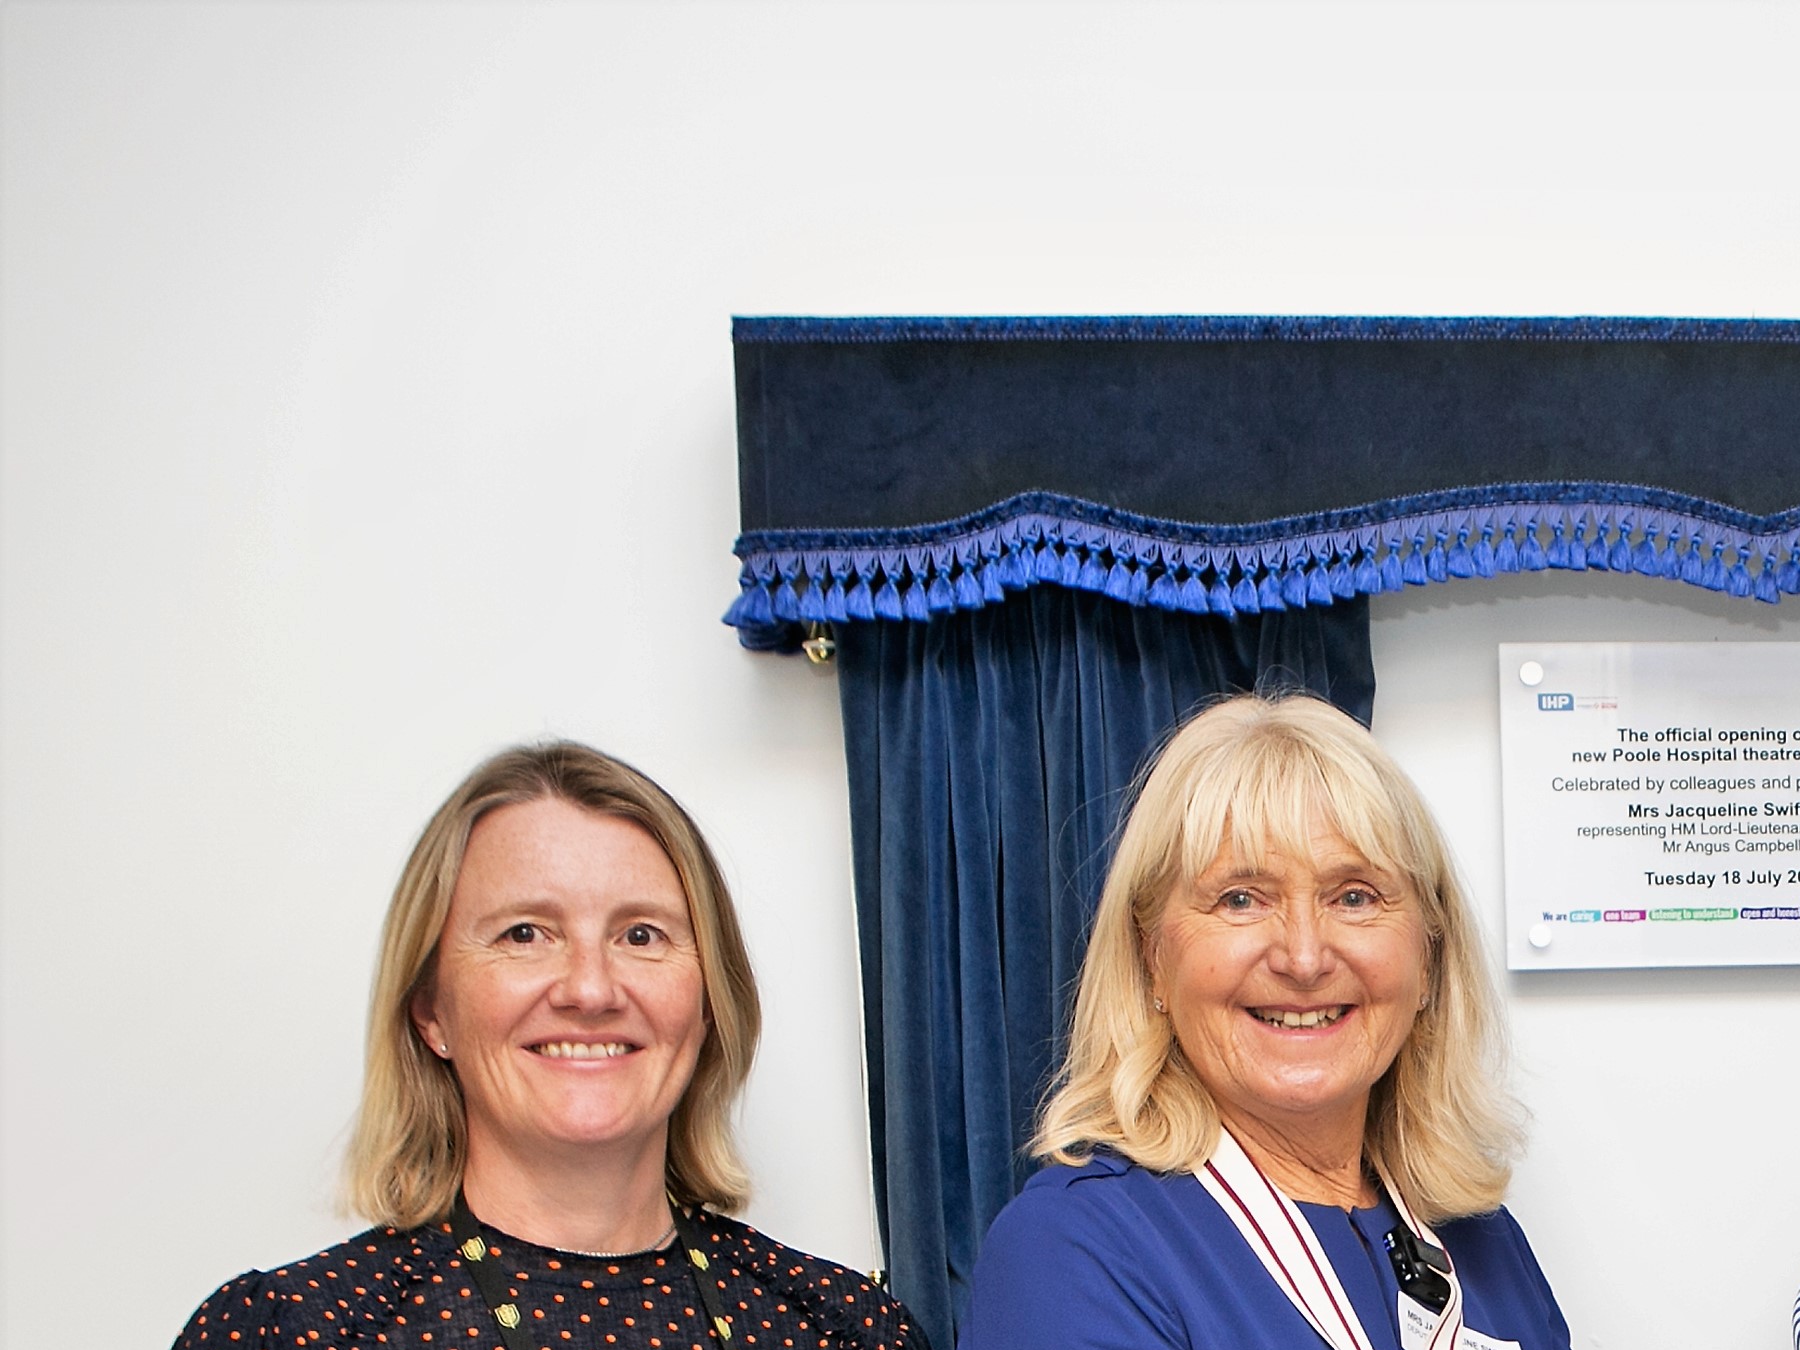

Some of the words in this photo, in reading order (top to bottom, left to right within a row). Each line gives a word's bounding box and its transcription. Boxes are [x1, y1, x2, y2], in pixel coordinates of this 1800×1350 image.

[1541, 695, 1569, 709] IHP
[1617, 728, 1649, 742] The
[1654, 727, 1712, 742] official
[1718, 727, 1788, 745] opening
[1572, 751, 1607, 762] new
[1612, 748, 1661, 762] Poole
[1666, 747, 1738, 764] Hospital
[1551, 777, 1641, 792] Celebrated
[1645, 776, 1665, 794] by
[1669, 775, 1756, 793] colleagues
[1761, 775, 1792, 789] and
[1628, 804, 1660, 818] Mrs
[1664, 803, 1758, 820] Jacqueline
[1577, 822, 1667, 838] representing
[1671, 823, 1696, 836] HM
[1663, 841, 1682, 853] Mr
[1685, 841, 1730, 856] Angus
[1644, 871, 1716, 888] Tuesday
[1722, 871, 1741, 885] 18
[1746, 871, 1783, 888] July
[1543, 912, 1554, 921] We
[1556, 913, 1567, 921] are
[1742, 909, 1761, 919] open
[1762, 908, 1776, 918] and
[1407, 1309, 1423, 1326] MRS
